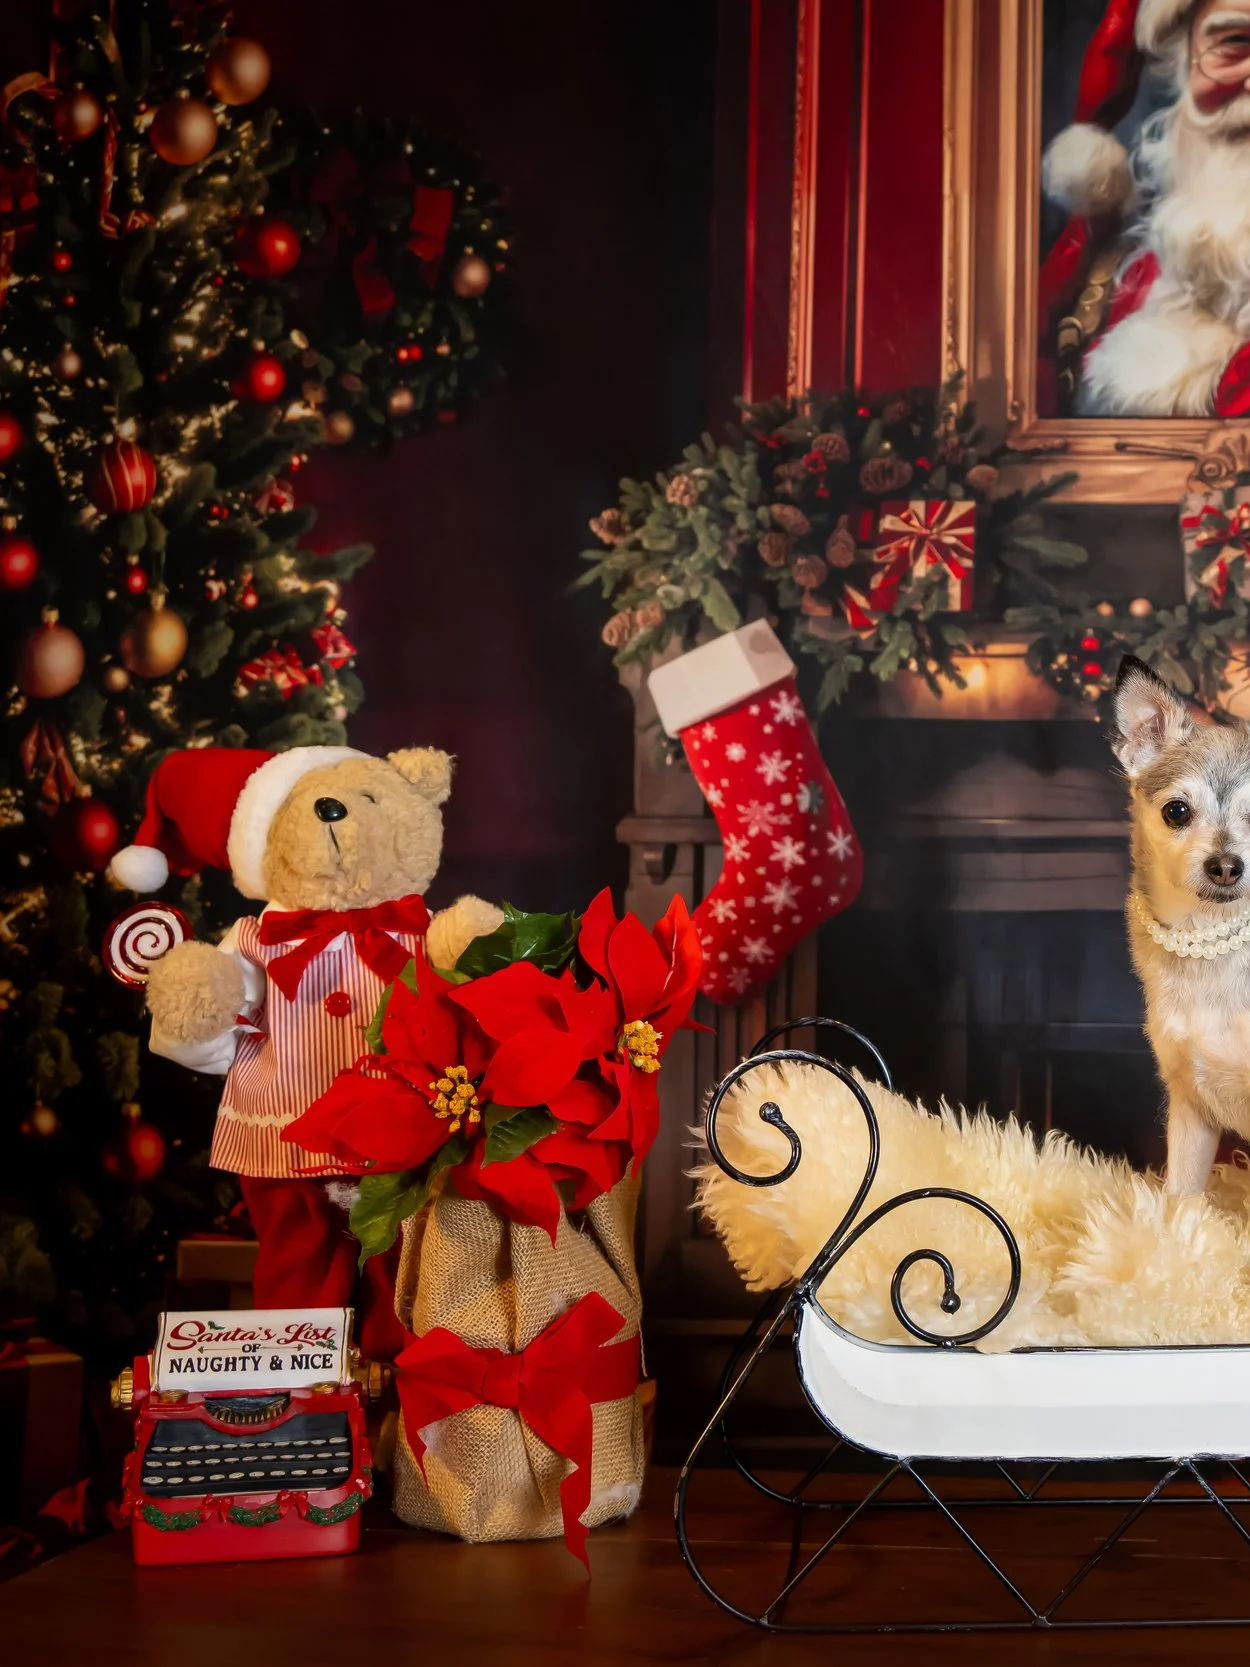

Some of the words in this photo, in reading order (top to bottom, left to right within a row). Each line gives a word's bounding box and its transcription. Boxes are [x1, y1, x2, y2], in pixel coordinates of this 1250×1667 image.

[166, 1320, 277, 1350] Santa's
[277, 1322, 337, 1347] List
[242, 1343, 262, 1353] OF
[169, 1355, 263, 1374] NAUGHTY
[269, 1355, 283, 1371] &
[291, 1354, 333, 1370] NICE
